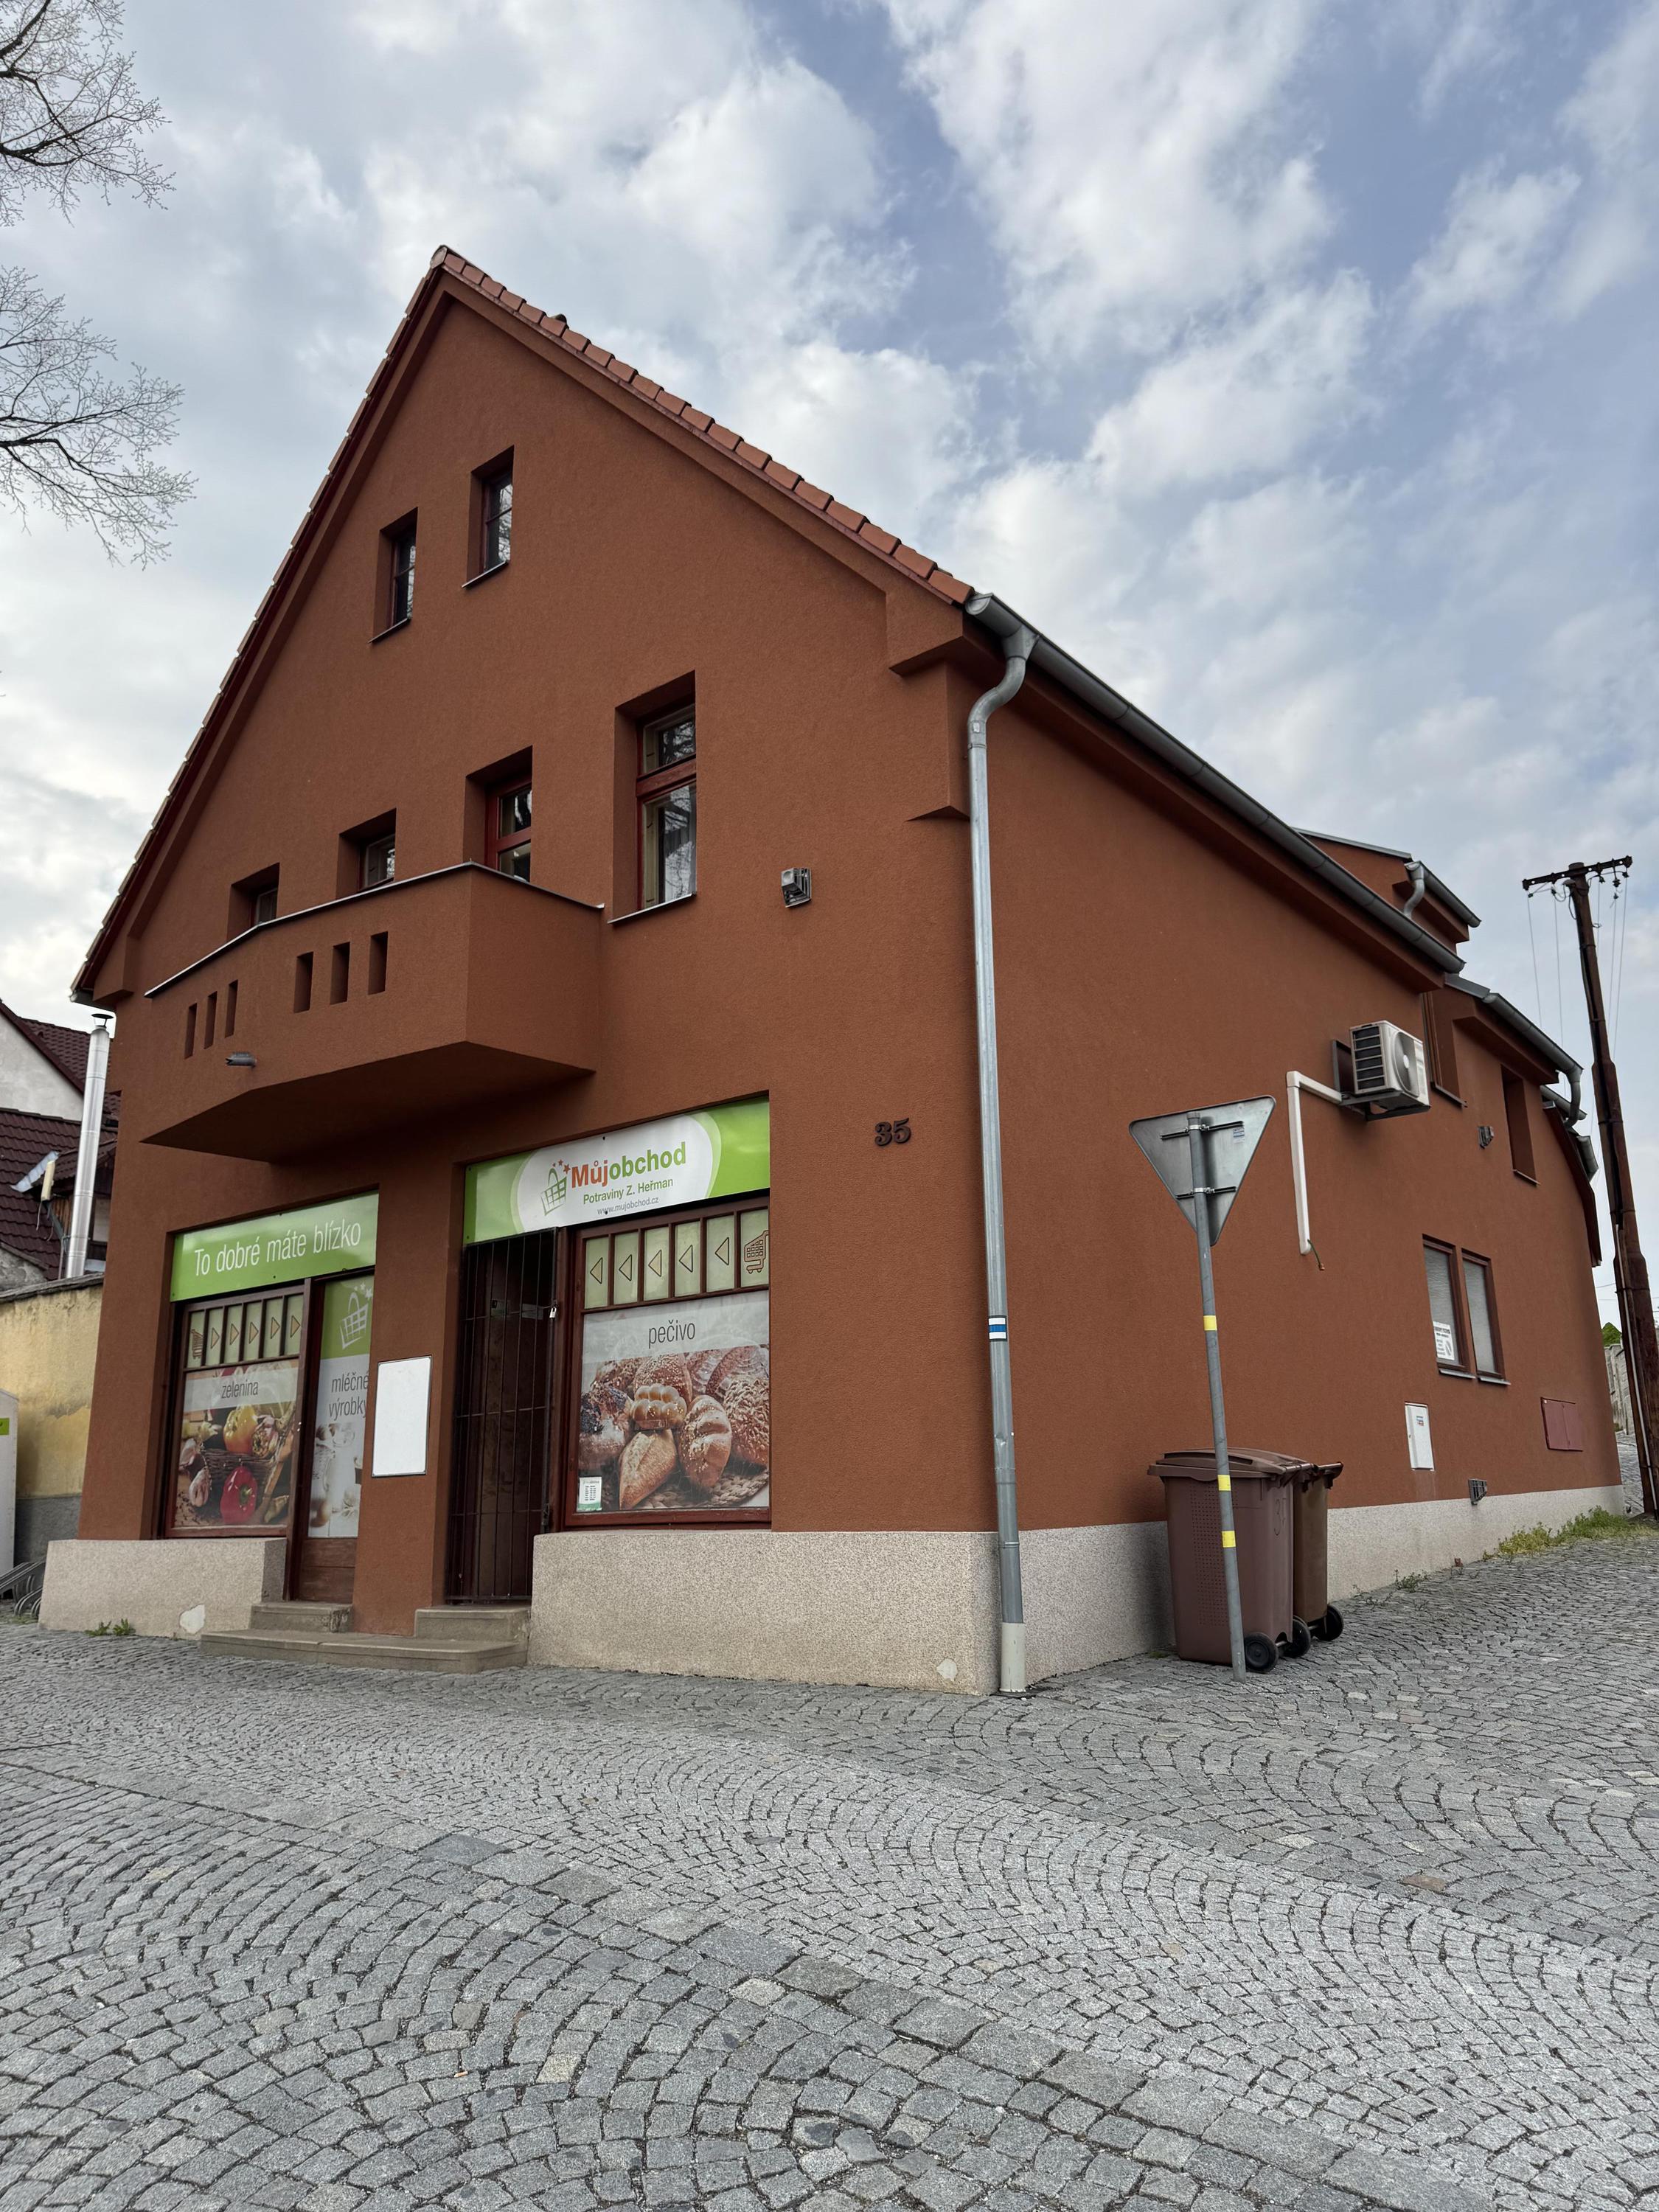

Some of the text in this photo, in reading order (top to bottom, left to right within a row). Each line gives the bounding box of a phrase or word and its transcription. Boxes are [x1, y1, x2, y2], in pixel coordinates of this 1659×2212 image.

[874, 1117, 911, 1146] 35
[571, 1141, 686, 1188] Můjobchod
[583, 1179, 673, 1205] Potraviny Z. Heřman
[597, 1197, 659, 1214] www.mujobchod.cz
[195, 1219, 361, 1276] To dobré máte blízko
[649, 1319, 695, 1349] pečivo
[221, 1378, 258, 1399] zelenina
[331, 1370, 369, 1393] mléčné
